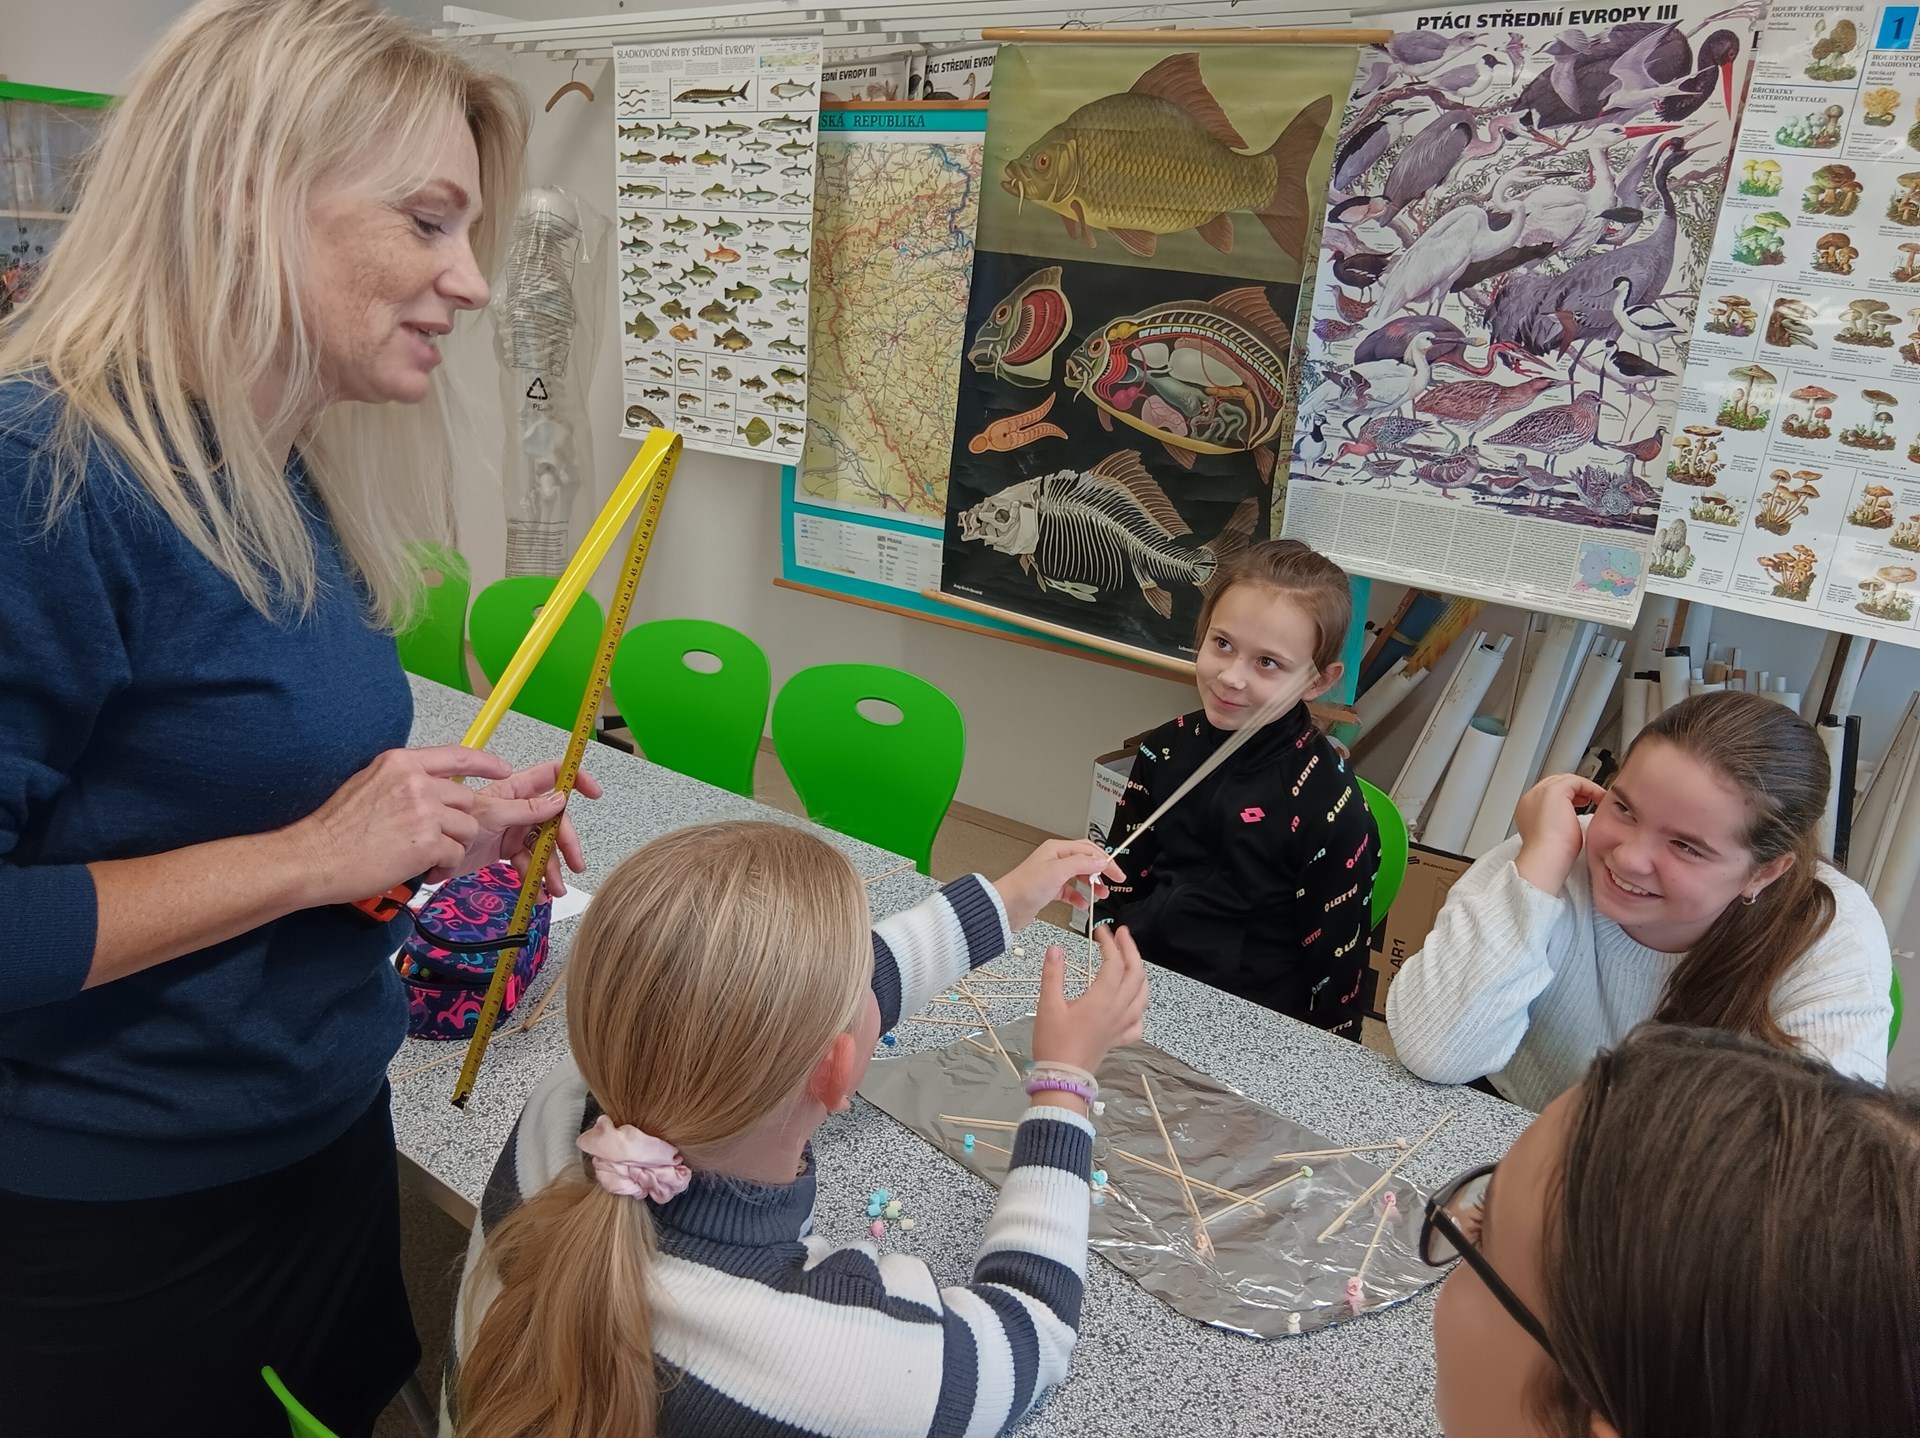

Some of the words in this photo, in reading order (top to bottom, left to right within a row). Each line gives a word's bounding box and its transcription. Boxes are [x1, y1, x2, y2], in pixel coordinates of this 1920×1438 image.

[1416, 12, 1471, 31] PTÁCI
[1477, 8, 1563, 28] STŘEDNÍ
[1568, 6, 1651, 26] EVROPY
[1656, 5, 1679, 21] III
[1892, 16, 1905, 40] 1
[617, 46, 670, 59] SLADKOVODNÍ
[671, 47, 690, 57] RYBY
[692, 44, 724, 56] STŘEDNÍ
[725, 45, 756, 55] EVROPY
[941, 56, 973, 73] STŘEDNÍ
[821, 69, 838, 82] EDNÍ
[839, 69, 868, 80] EVROPY
[869, 67, 877, 77] III
[820, 113, 845, 128] SKÁ
[853, 114, 926, 128] REPUBLIKA
[664, 457, 671, 465] 54
[660, 469, 668, 478] 53
[656, 481, 664, 491] 52
[652, 494, 660, 503] 51
[649, 505, 657, 515] 50
[645, 519, 653, 528] 49
[642, 531, 650, 540] 48
[638, 544, 646, 552] 47
[634, 556, 642, 565] 46
[630, 568, 638, 577] 45
[627, 580, 634, 589] 44
[623, 592, 631, 601] 43
[620, 605, 627, 613] 42
[616, 617, 623, 625] 41
[612, 629, 620, 638] 40
[608, 641, 616, 650] 39
[604, 653, 612, 662] 38
[601, 665, 608, 674] 37
[593, 689, 600, 698] 35
[590, 701, 596, 710] 34
[586, 714, 593, 722] 33
[582, 726, 589, 734] 32
[570, 761, 577, 770] 29
[1297, 755, 1319, 787] LOTTO
[1096, 780, 1123, 798] Three-Wa
[1333, 785, 1352, 813] LOTTO
[1330, 883, 1358, 908] LOTTO
[1390, 938, 1406, 969] AR1
